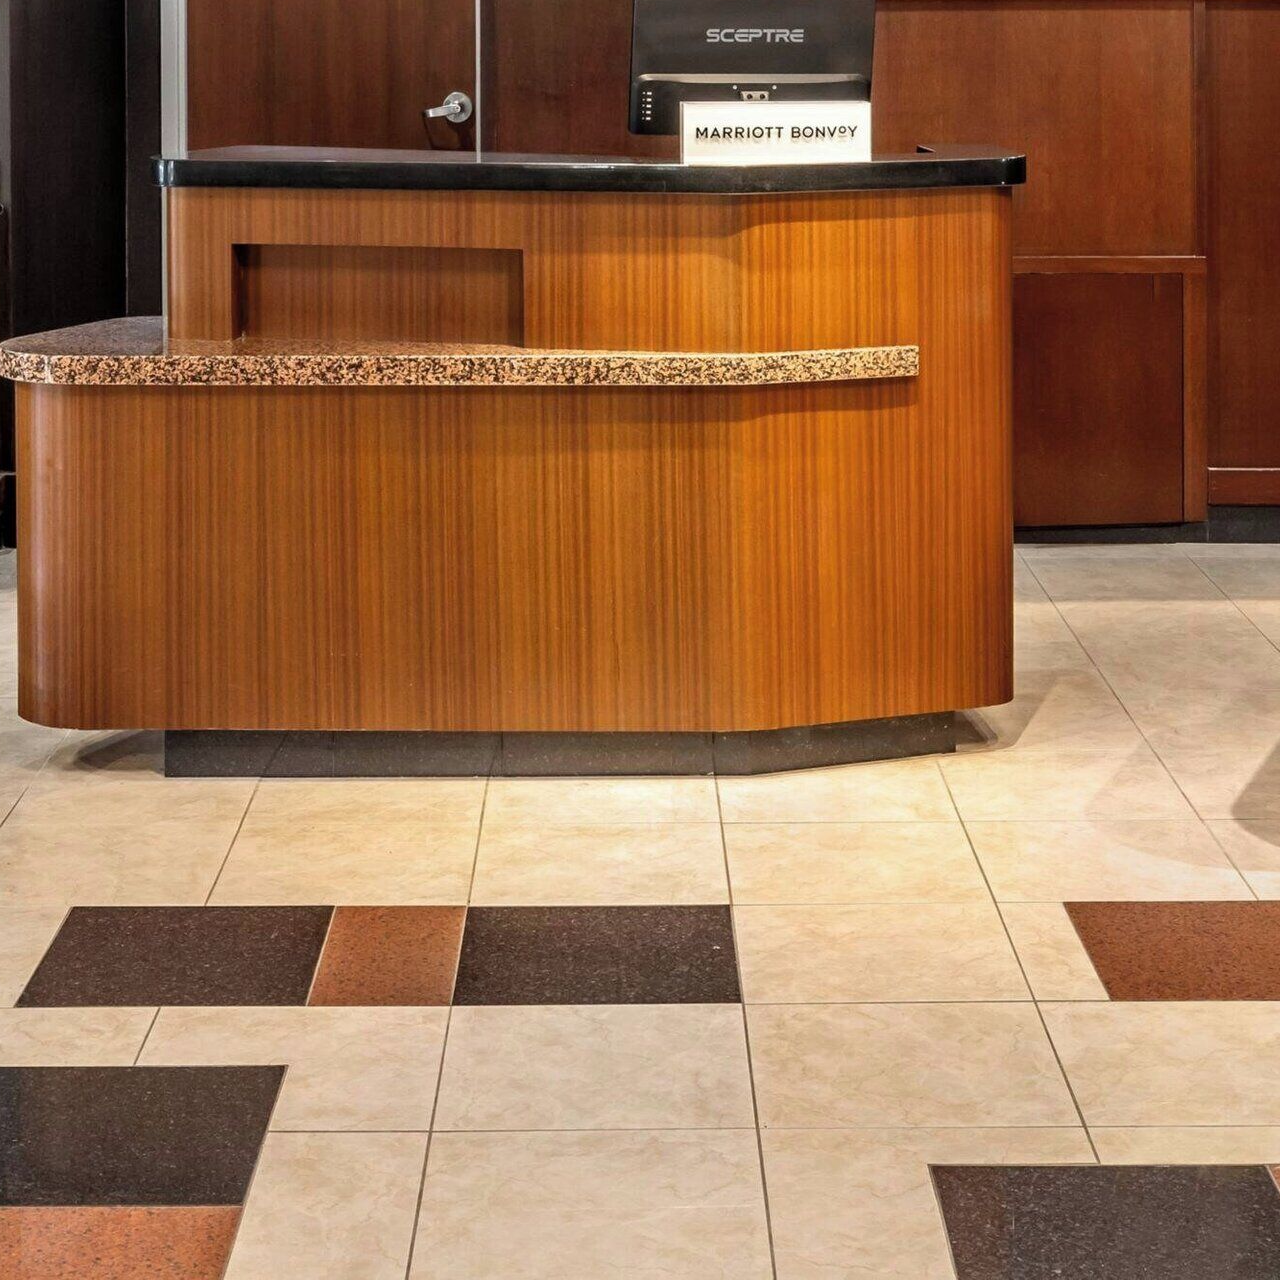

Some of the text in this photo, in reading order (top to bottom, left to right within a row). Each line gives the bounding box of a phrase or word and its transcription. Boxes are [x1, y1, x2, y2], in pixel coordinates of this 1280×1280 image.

[706, 28, 805, 43] SCEPTRE
[696, 125, 858, 139] MARRIOTT BONVOY
